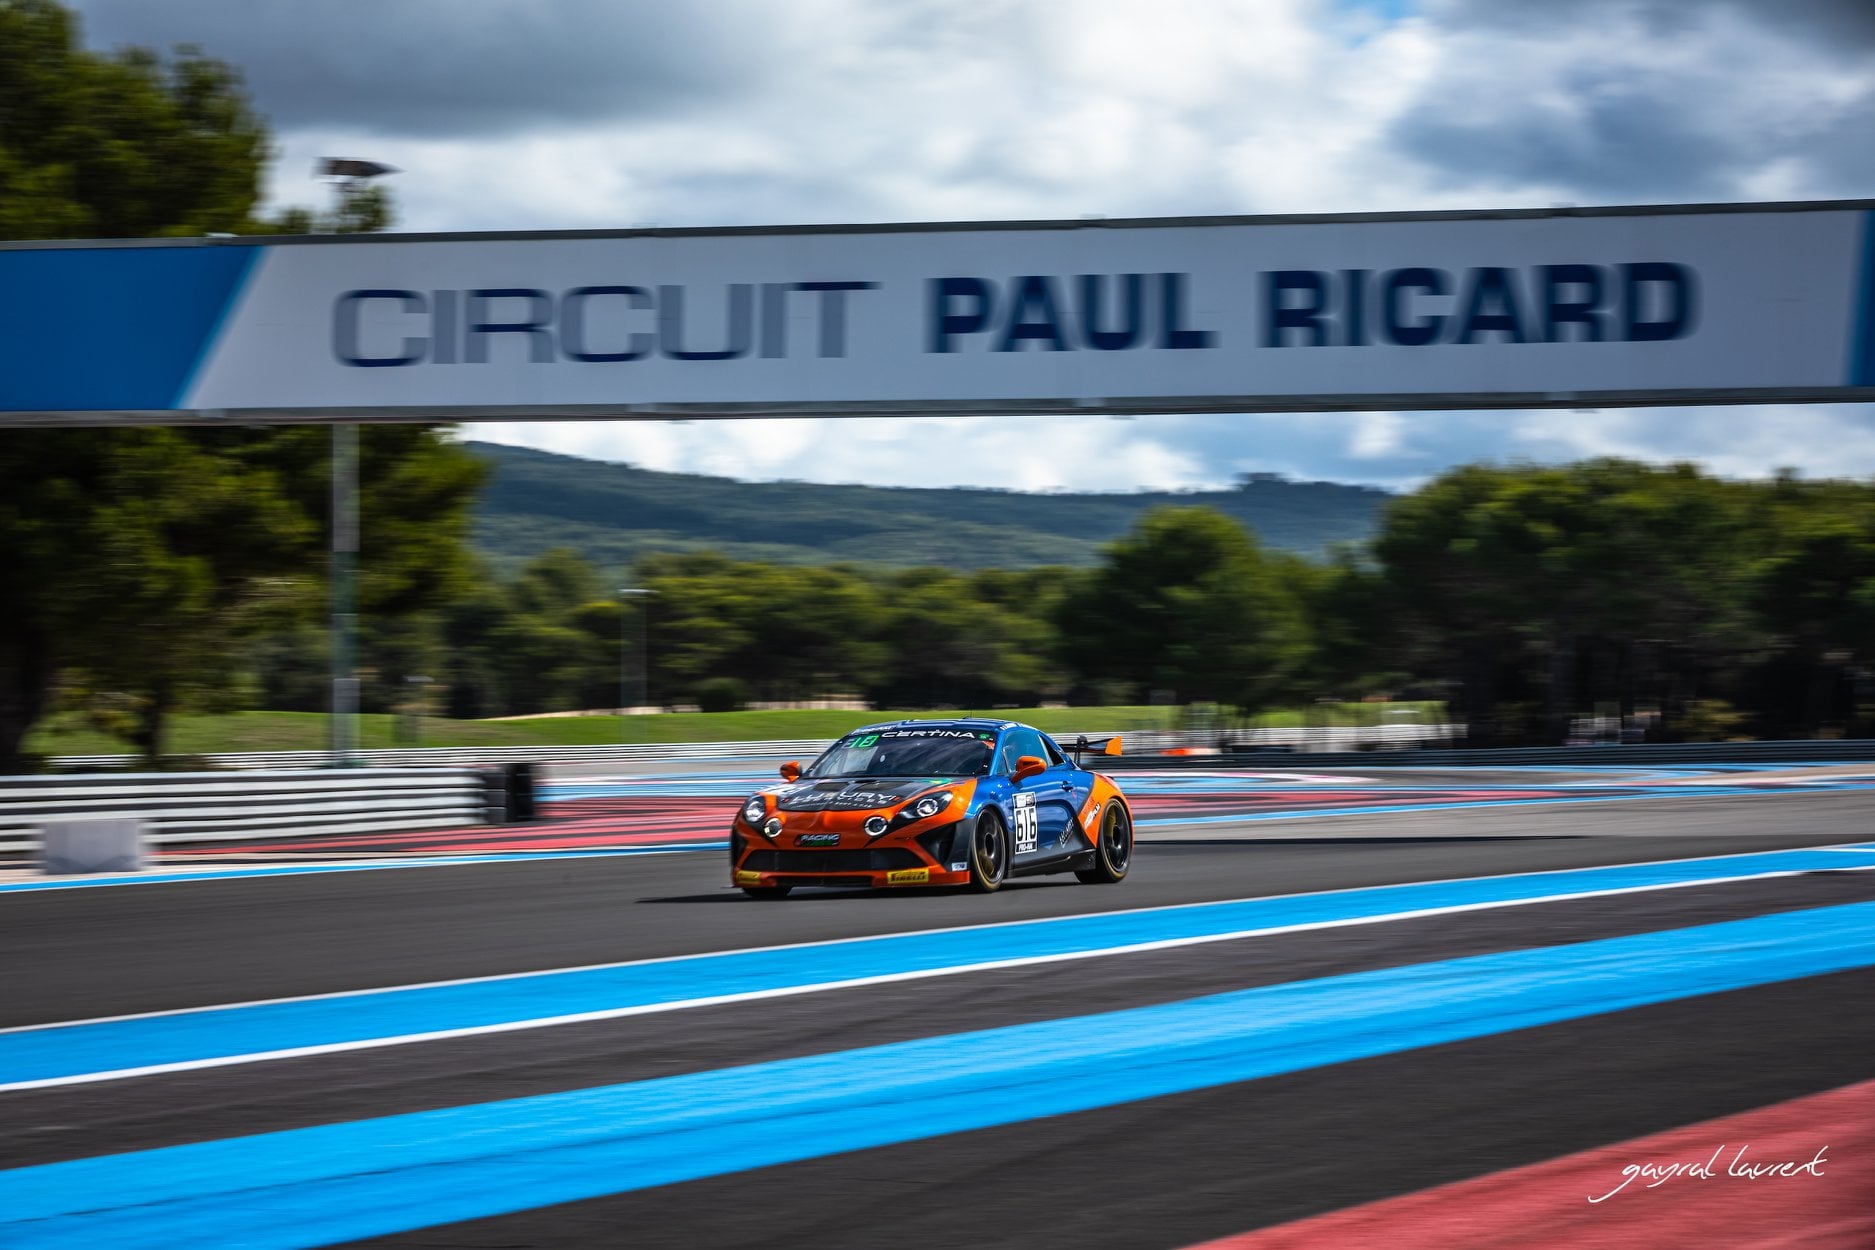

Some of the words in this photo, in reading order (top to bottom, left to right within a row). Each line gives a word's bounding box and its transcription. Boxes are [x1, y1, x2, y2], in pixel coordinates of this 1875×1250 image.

[330, 281, 883, 367] CIRCUIT
[924, 272, 1220, 354] PAUL
[1257, 261, 1704, 348] RICARD
[881, 730, 975, 739] CERTINA
[1015, 808, 1037, 842] 616
